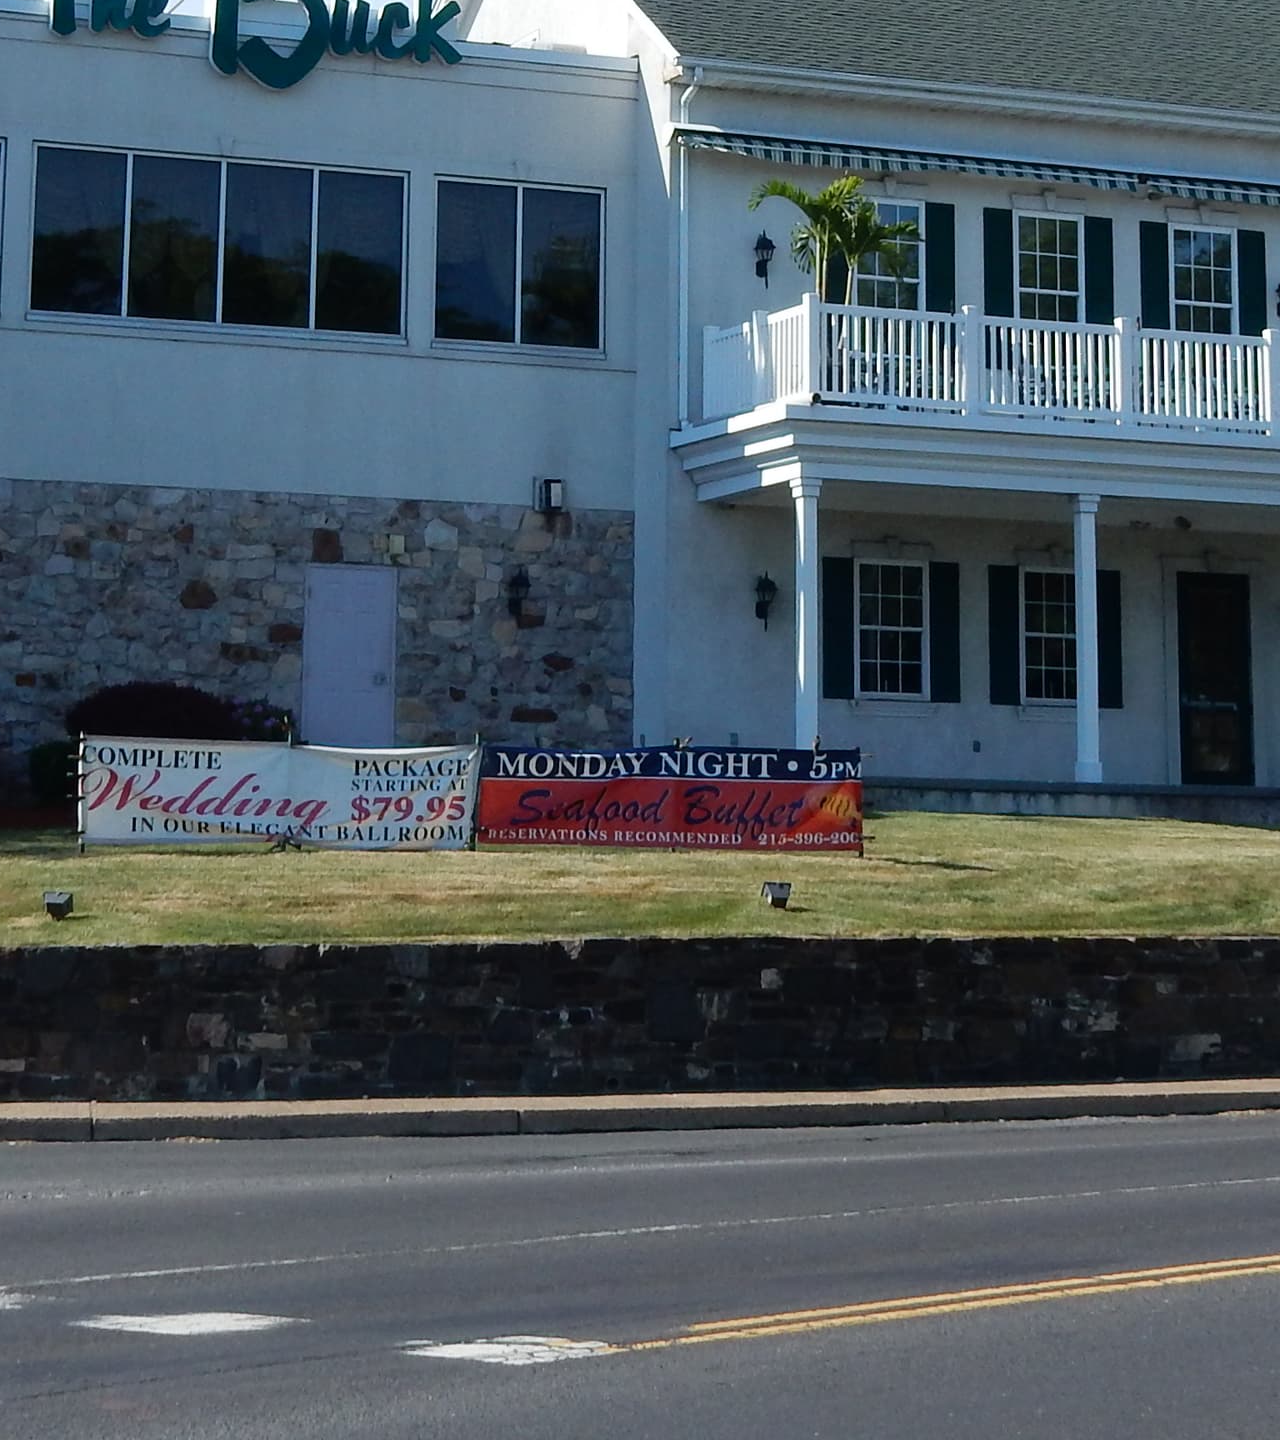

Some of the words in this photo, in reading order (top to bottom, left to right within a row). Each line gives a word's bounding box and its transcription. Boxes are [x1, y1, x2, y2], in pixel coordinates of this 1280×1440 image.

[83, 744, 222, 770] COMPLETE
[354, 759, 470, 777] PACKAGE
[497, 752, 649, 778] MONDAY
[660, 751, 778, 778] NIGHT
[351, 779, 441, 792] STARTING
[448, 779, 468, 791] AT
[81, 767, 330, 841] Wedding
[351, 795, 466, 824] $79.95
[511, 786, 670, 832] Seafood
[683, 785, 806, 841] Buffet
[132, 817, 154, 833] IN
[164, 817, 209, 834] OUR
[337, 825, 463, 841] BALLROOM
[488, 828, 607, 841] RESERVATIONS
[614, 831, 742, 845] RECOMMENDED
